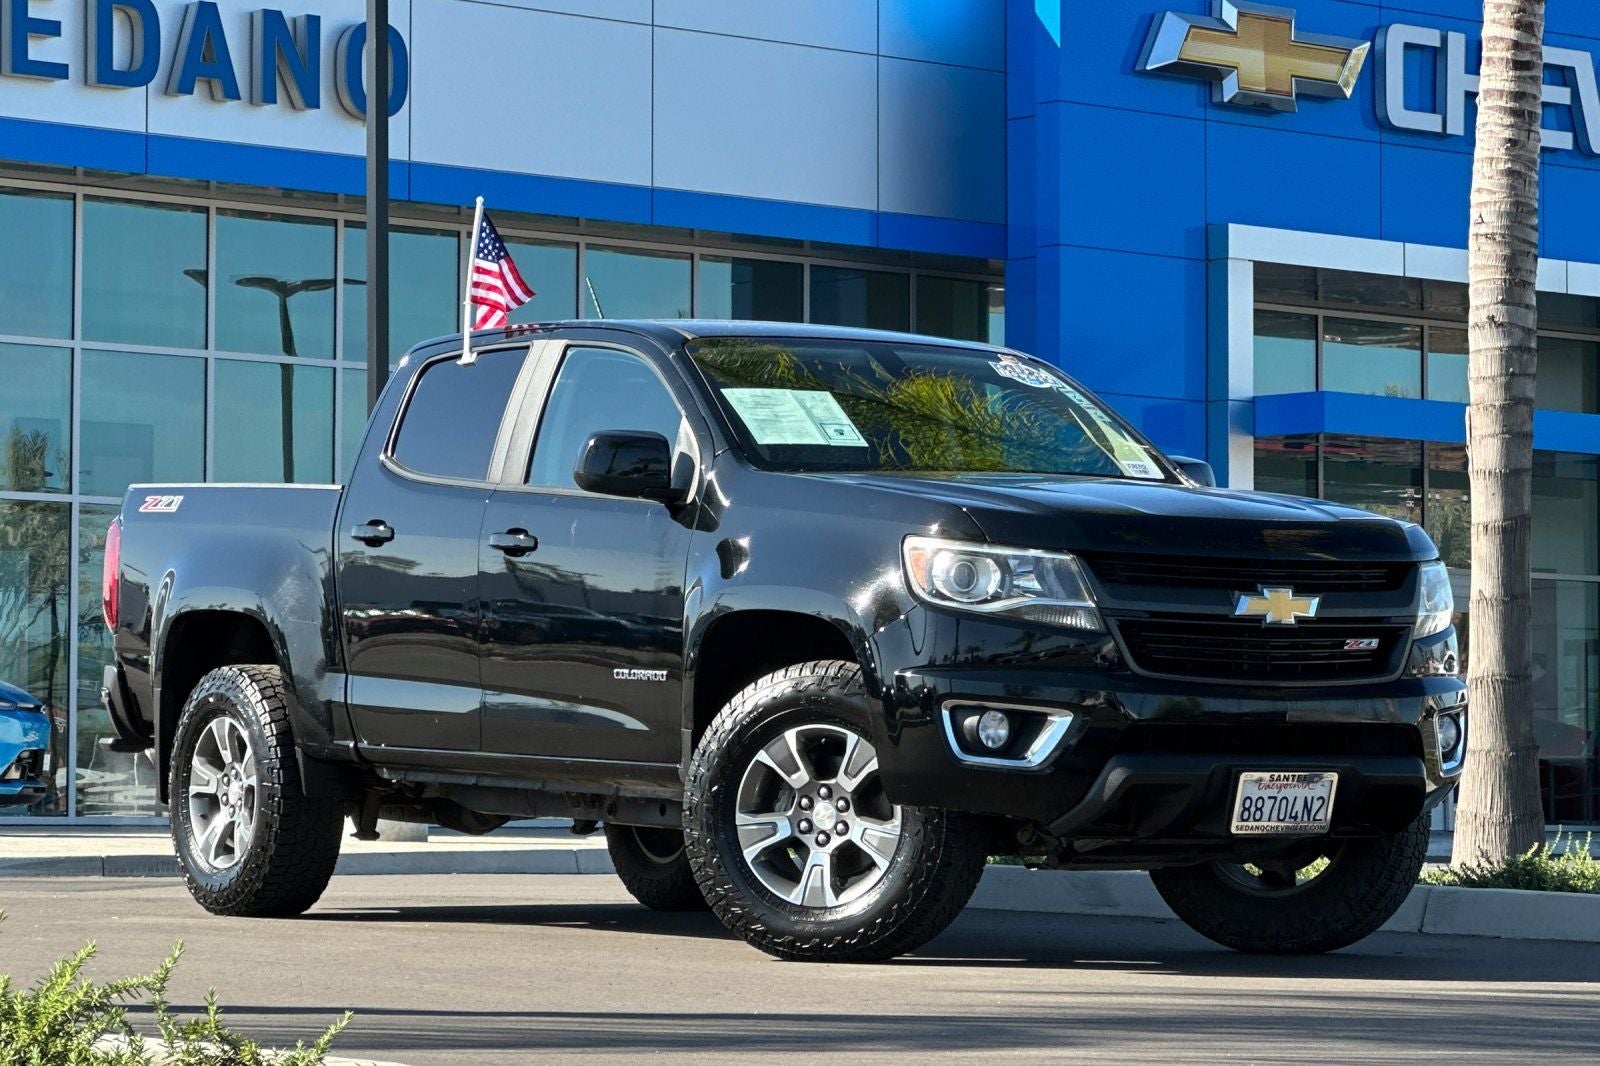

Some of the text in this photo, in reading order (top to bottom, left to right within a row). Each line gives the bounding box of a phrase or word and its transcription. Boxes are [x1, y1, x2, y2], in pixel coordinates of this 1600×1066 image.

[139, 495, 184, 512] Z71
[613, 668, 668, 681] COLORADO
[1269, 774, 1309, 782] SANTEE
[1241, 796, 1326, 822] 88704N2
